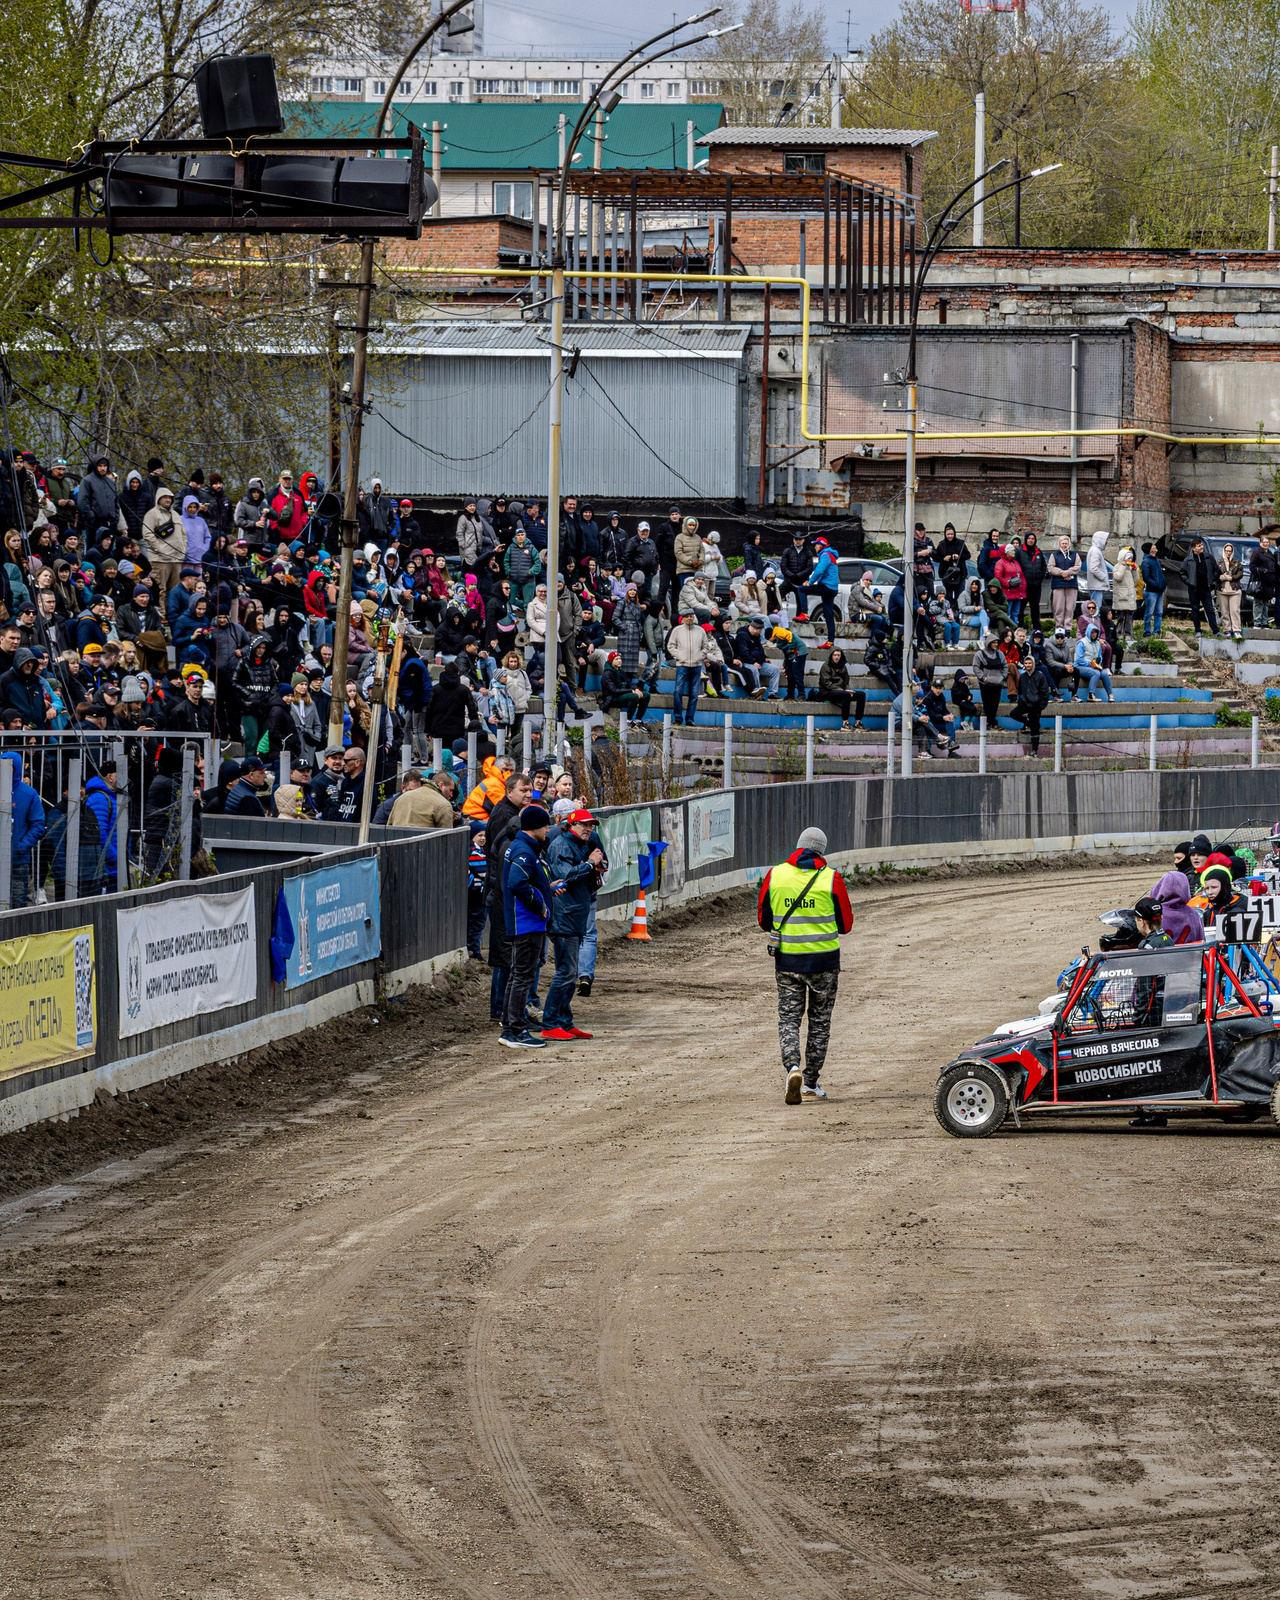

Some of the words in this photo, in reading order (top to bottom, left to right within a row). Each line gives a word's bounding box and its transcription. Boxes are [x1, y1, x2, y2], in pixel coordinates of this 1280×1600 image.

[1252, 898, 1275, 923] 11
[1230, 913, 1260, 941] 17
[145, 937, 174, 965] УПРАВЛЕНИЕ
[175, 925, 206, 956] ФИЗИЧЕСКОЙ
[206, 927, 229, 951] КУЛЬТУРЫ
[233, 921, 249, 945] СПОРТА
[6, 959, 43, 992] ОРГАНИЗАЦИЯ
[43, 954, 65, 982] ОХРАНЫ
[145, 975, 162, 1000] МЭРИИ
[162, 971, 181, 996] ГОРОДА
[181, 963, 218, 990] НОВОСИБИРСКА
[1099, 968, 1134, 978] MOTUL
[6, 1019, 24, 1049] СРЕДЫ
[1073, 1045, 1109, 1058] ЧЕРНОВ
[1111, 1038, 1160, 1053] ВЯЧЕСЛАВ
[1074, 1059, 1162, 1084] НОВОСИБИРСК
